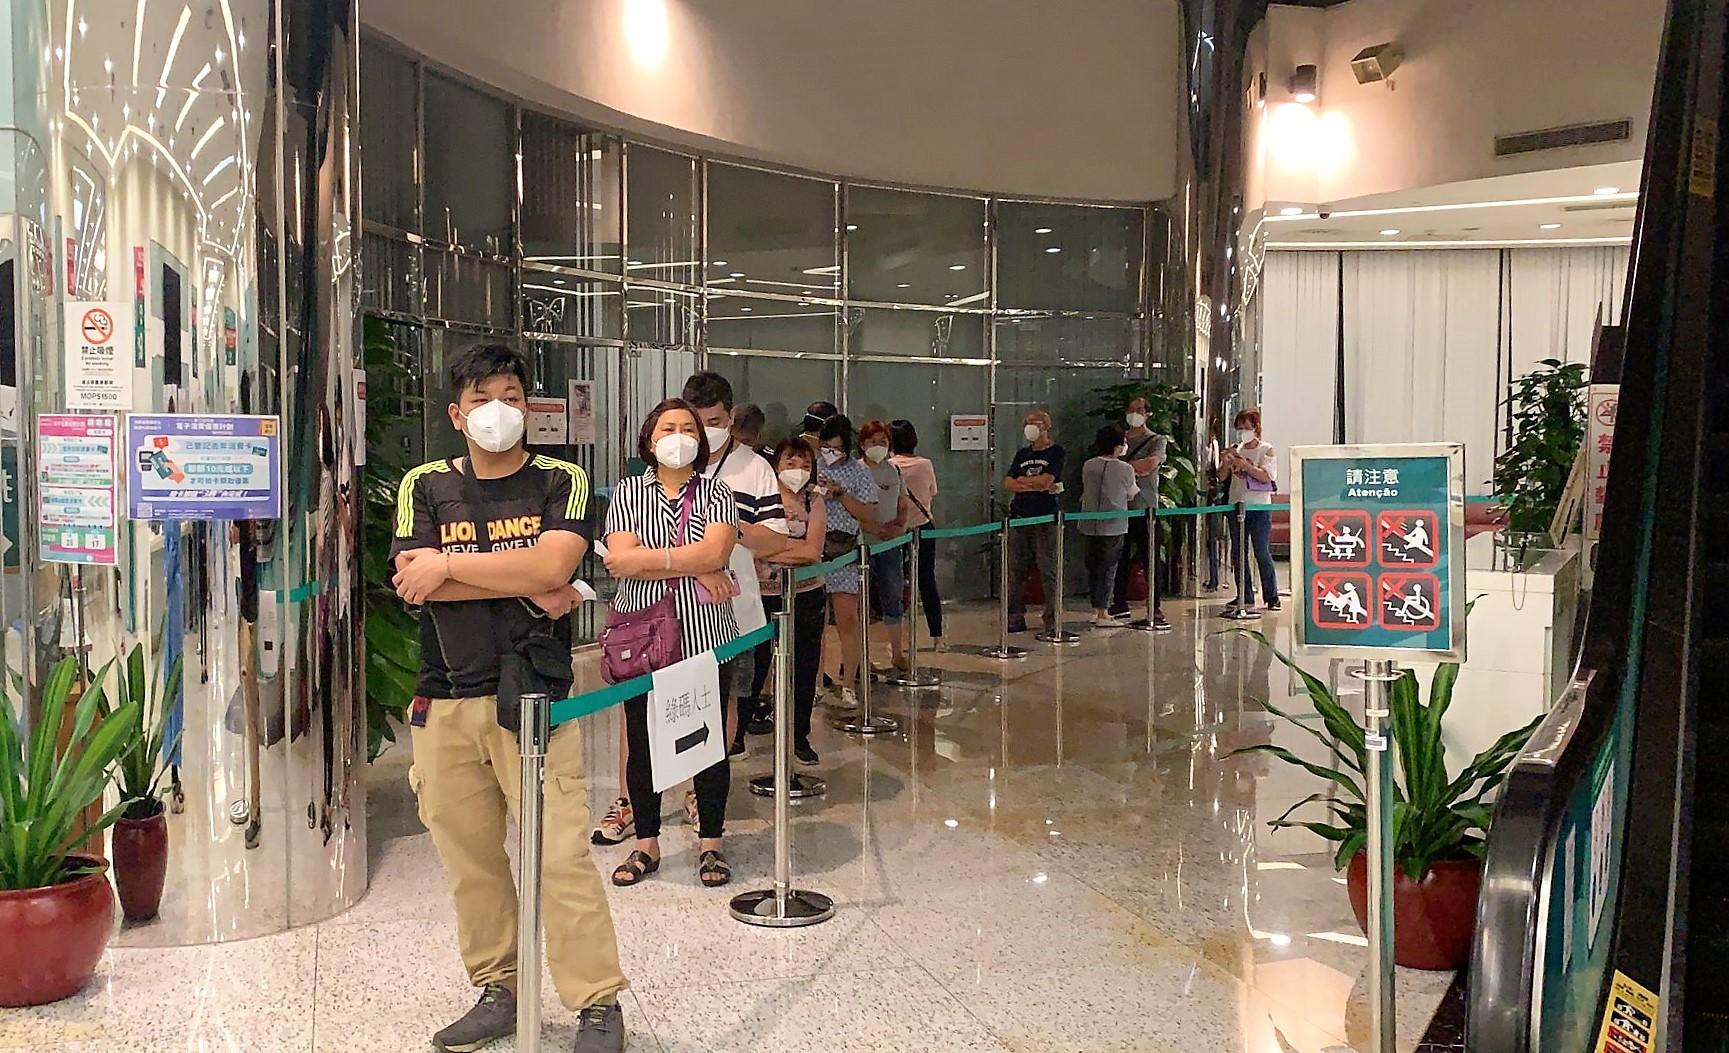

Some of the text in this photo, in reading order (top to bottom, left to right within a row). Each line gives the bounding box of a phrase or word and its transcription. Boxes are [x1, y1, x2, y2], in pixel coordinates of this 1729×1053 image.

[81, 346, 114, 355] 禁止吸煙
[1346, 468, 1400, 485] 請注意
[1347, 487, 1399, 499] Atenção
[440, 521, 477, 544] LIO
[441, 543, 480, 553] NEVE
[491, 540, 524, 553] GIVE
[665, 684, 712, 724] 綠碼人士
